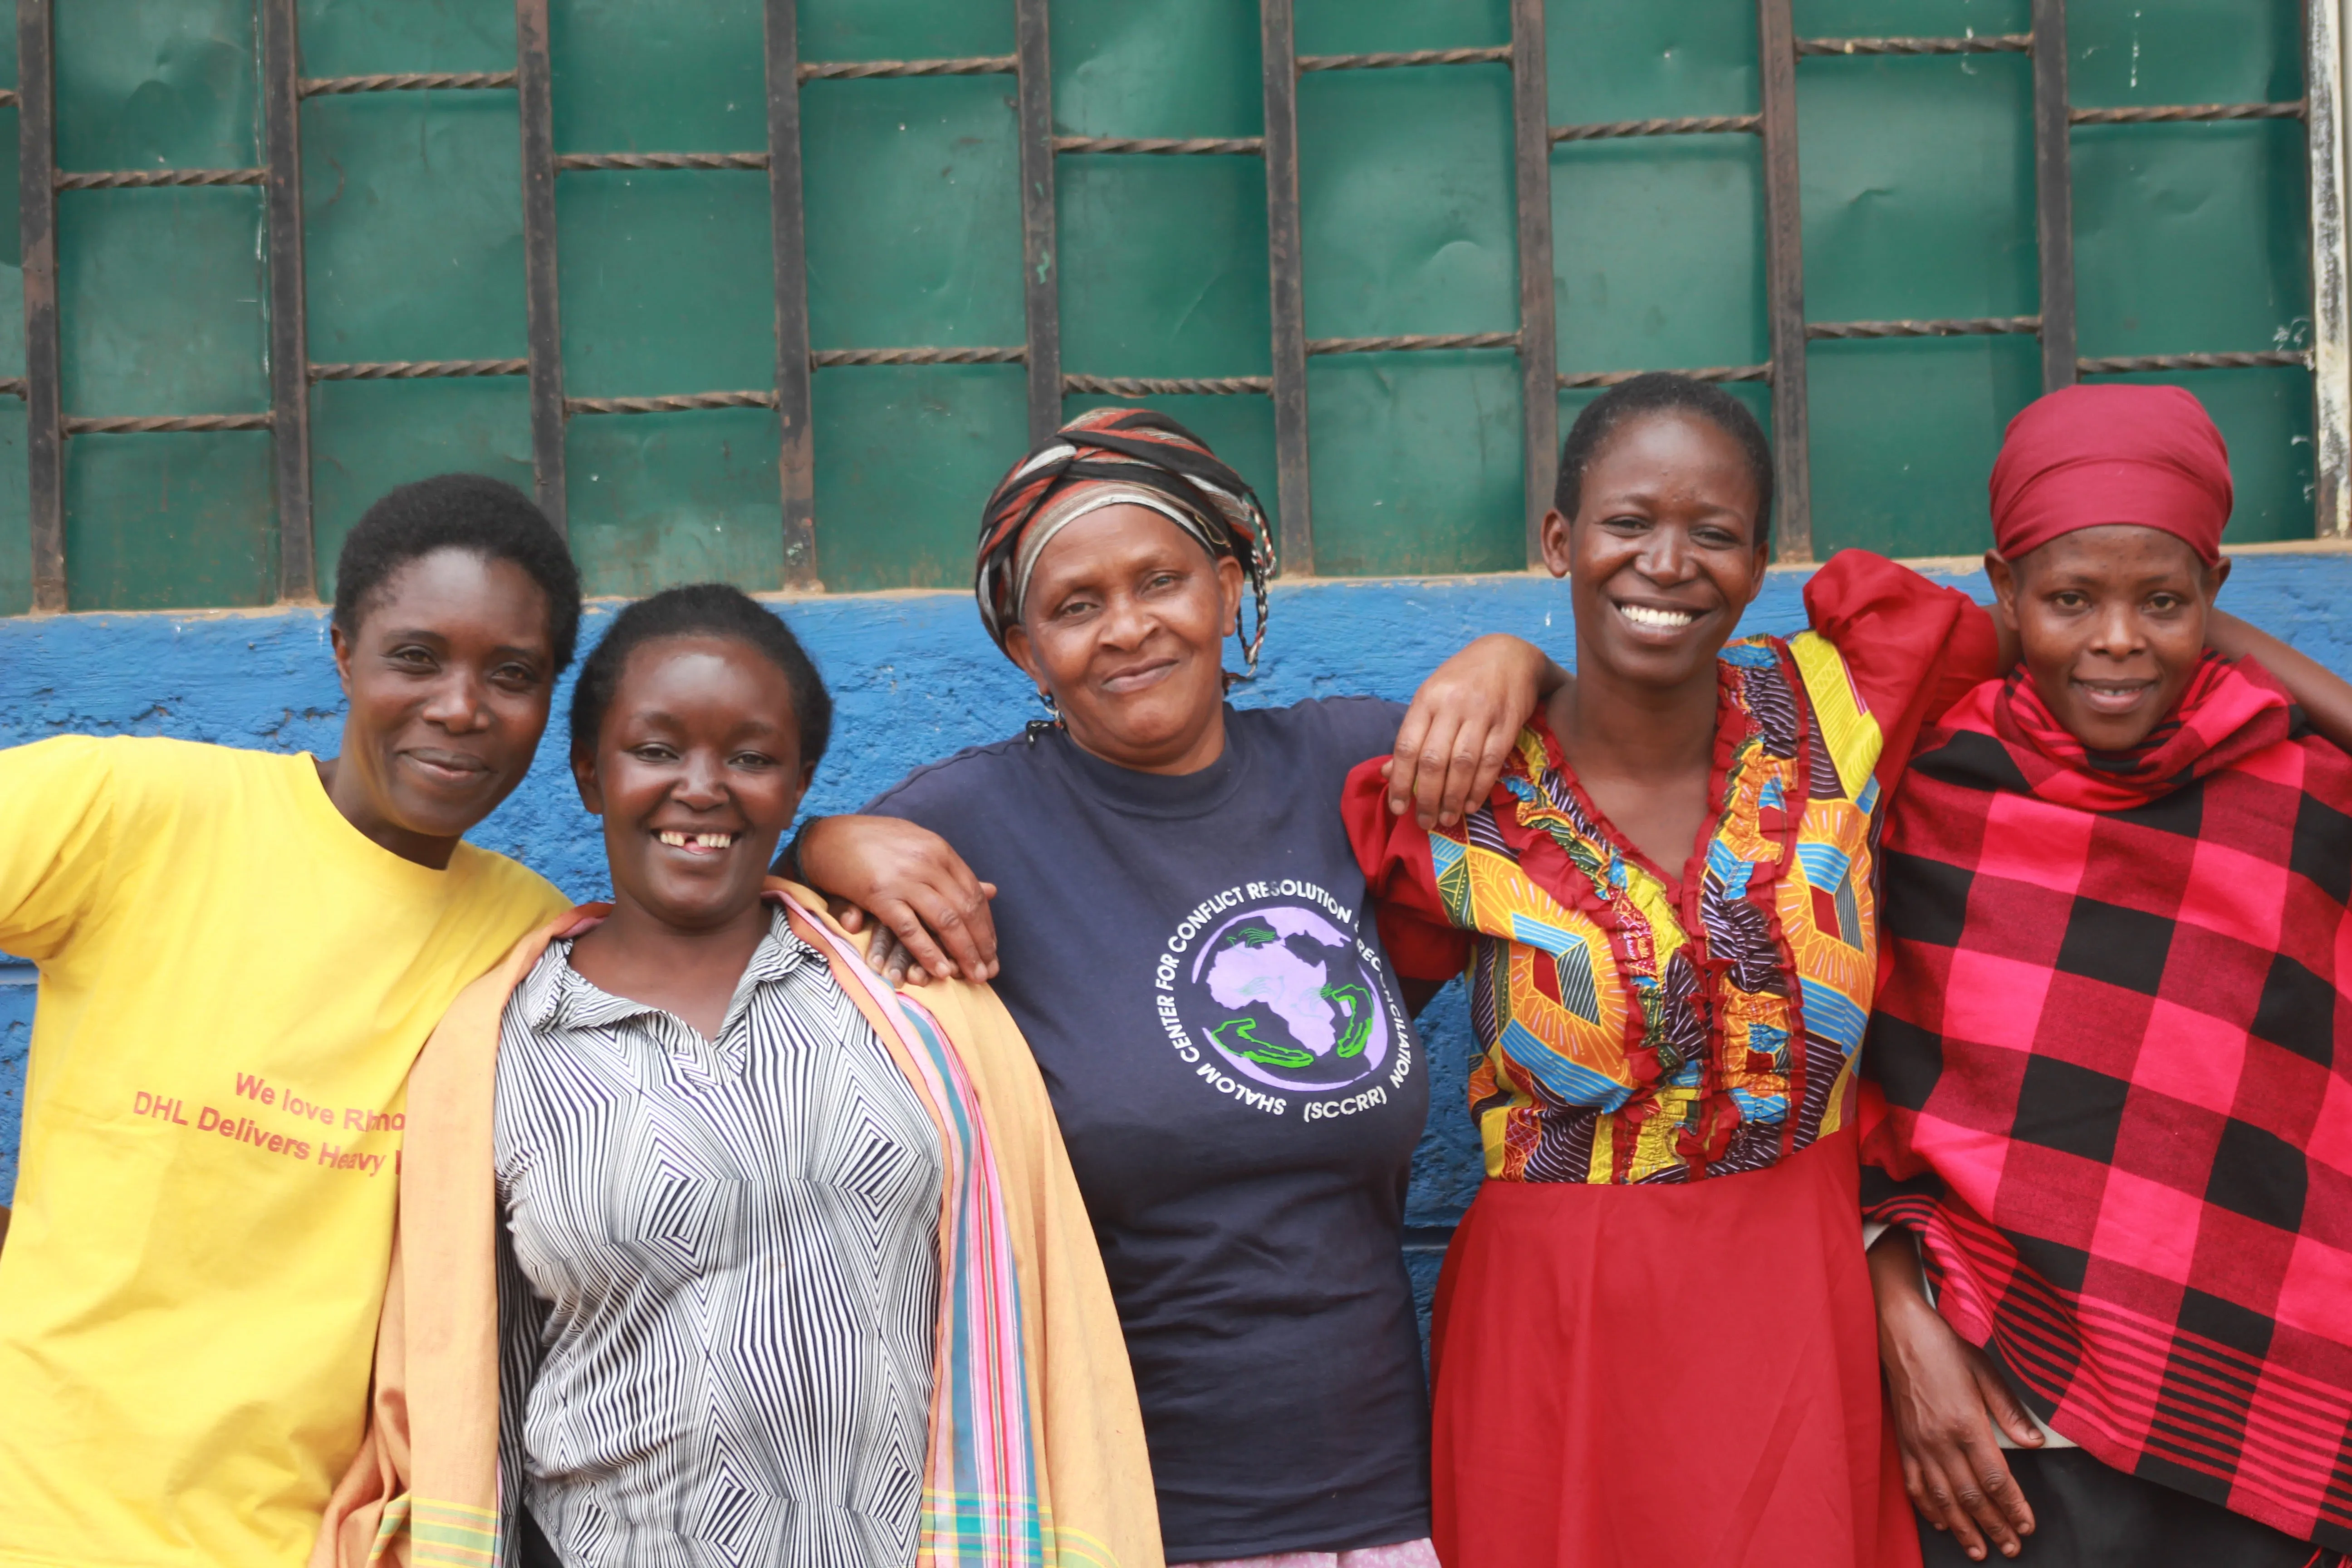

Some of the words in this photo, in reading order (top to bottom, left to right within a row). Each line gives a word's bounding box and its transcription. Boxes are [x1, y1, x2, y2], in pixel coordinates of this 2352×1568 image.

[1168, 887, 1245, 953] CONFLICT
[1246, 879, 1352, 923] RESOLUTION
[1156, 953, 1180, 991] FOR
[1157, 995, 1200, 1063] CENTER
[236, 1072, 275, 1105] We
[282, 1089, 334, 1125] love
[1196, 1062, 1287, 1115] SHALOM
[1303, 1086, 1387, 1122] (SCCRR)
[133, 1091, 188, 1126] DHL
[197, 1106, 311, 1160] Delivers
[318, 1142, 387, 1177] Heavy
